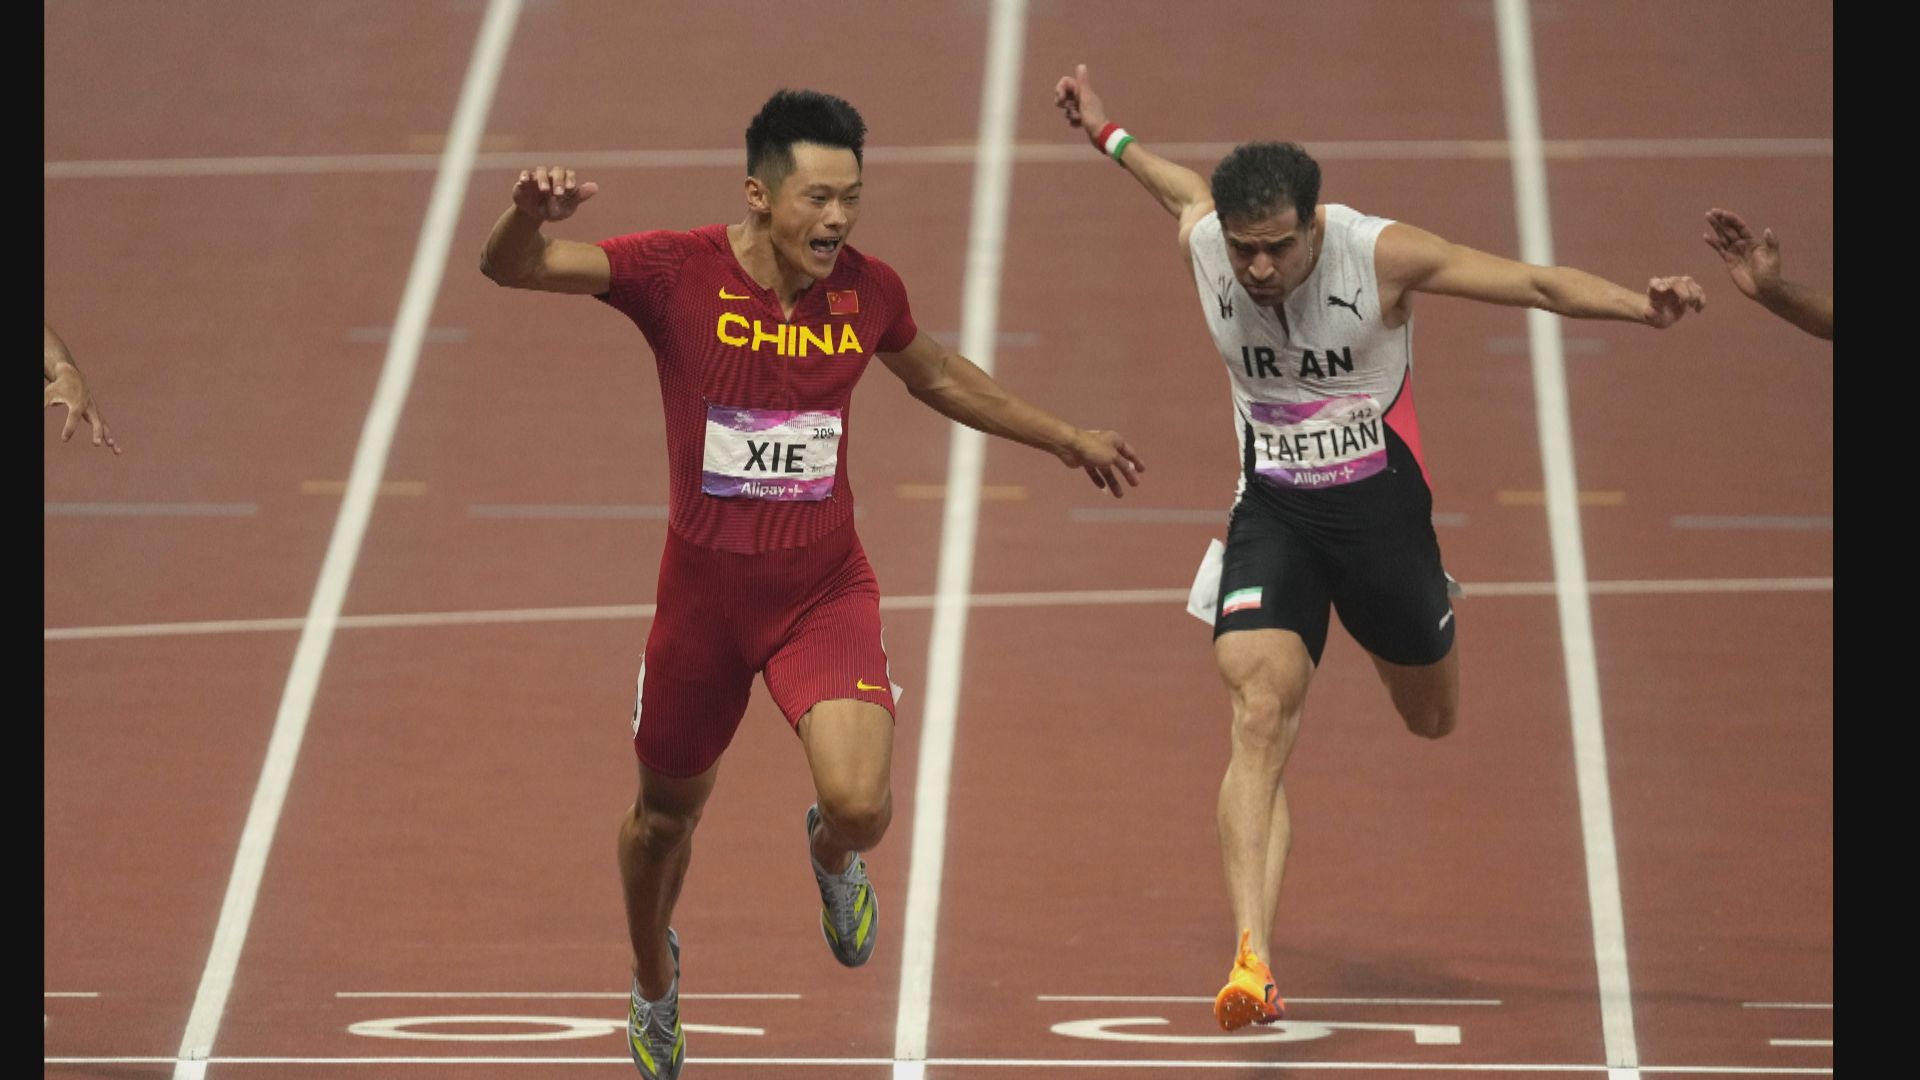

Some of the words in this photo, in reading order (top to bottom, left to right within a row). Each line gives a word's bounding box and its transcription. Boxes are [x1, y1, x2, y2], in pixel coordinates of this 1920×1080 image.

[717, 312, 864, 357] CHINA
[743, 440, 807, 473] XIE
[1260, 418, 1380, 463] TAFTIAN
